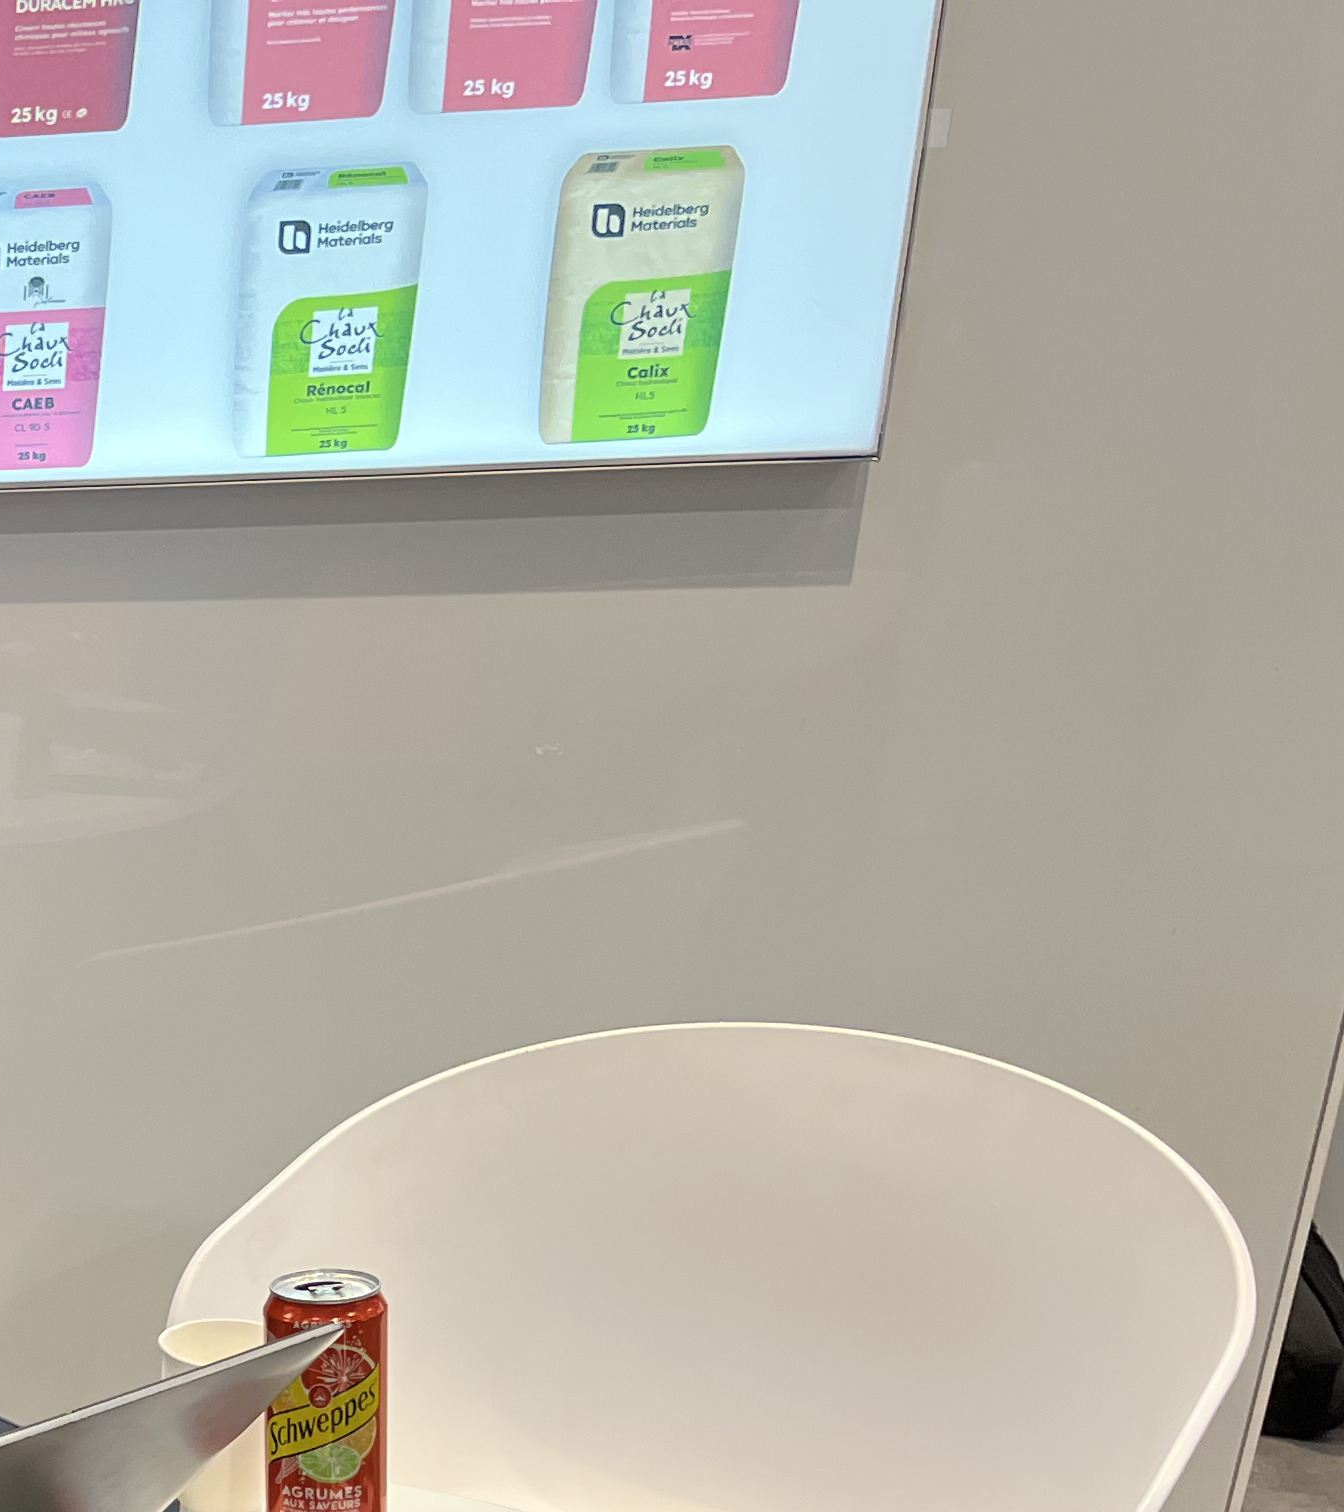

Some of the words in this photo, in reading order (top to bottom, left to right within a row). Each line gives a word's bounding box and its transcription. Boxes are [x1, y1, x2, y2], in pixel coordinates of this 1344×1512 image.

[665, 71, 686, 87] 25
[689, 69, 713, 90] kg
[463, 80, 485, 96] 25
[491, 78, 515, 99] kg
[262, 93, 283, 110] 25
[286, 91, 310, 112] kg
[11, 107, 32, 124] 25
[35, 106, 57, 126] kg
[632, 203, 709, 218] Heidelberg
[318, 220, 394, 234] Heidelberg
[631, 217, 697, 232] Materials
[7, 240, 80, 254] Heidelberg
[317, 233, 382, 248] Materials
[6, 253, 70, 268] Materials
[627, 364, 670, 380] Calix
[306, 380, 370, 397] Rénocal
[12, 397, 54, 411] CAEB
[627, 424, 639, 434] 25
[642, 423, 655, 434] kg
[319, 440, 331, 449] 25
[334, 439, 348, 449] kg
[18, 452, 30, 460] 25
[32, 451, 46, 462] kg
[269, 1382, 378, 1455] Schweppes
[281, 1485, 362, 1500] AGRUMES
[283, 1498, 305, 1509] AUX
[309, 1498, 361, 1511] SAVEURS
